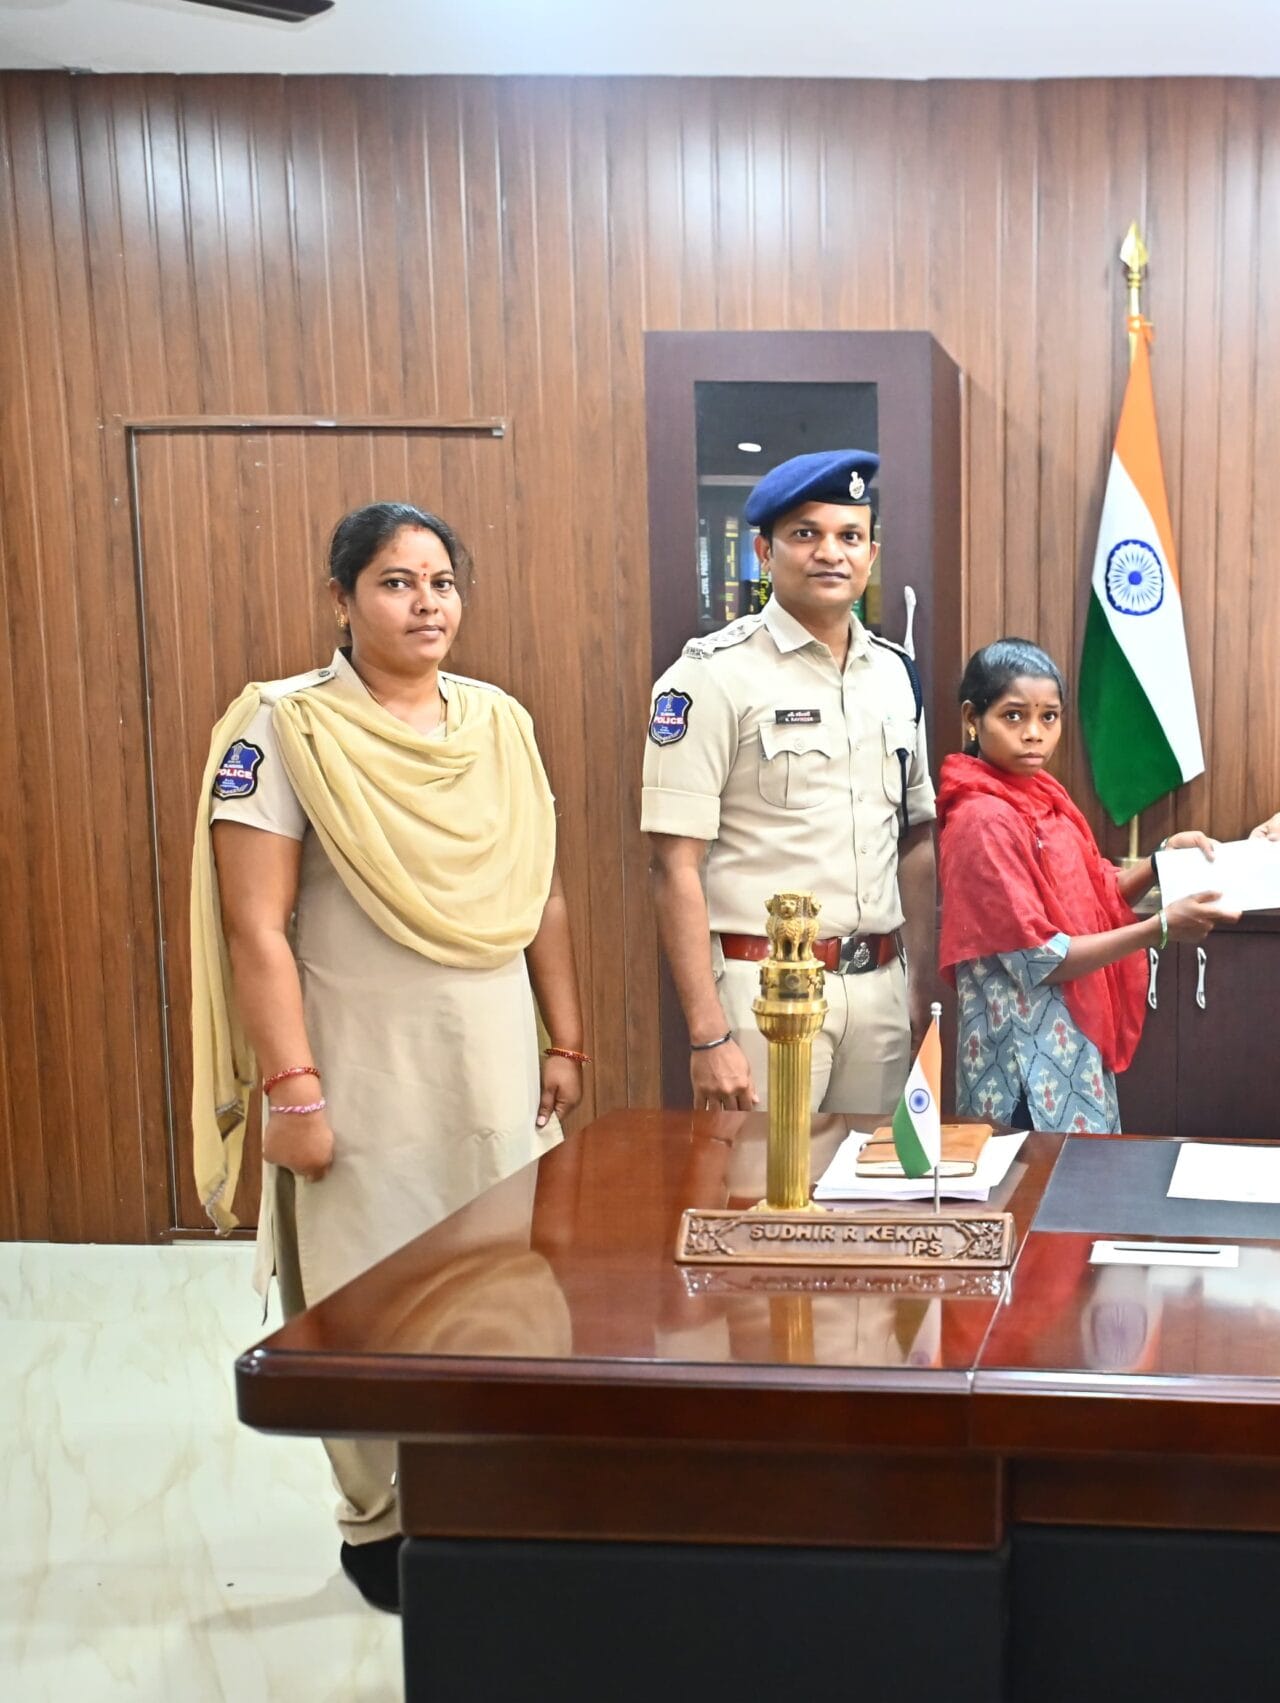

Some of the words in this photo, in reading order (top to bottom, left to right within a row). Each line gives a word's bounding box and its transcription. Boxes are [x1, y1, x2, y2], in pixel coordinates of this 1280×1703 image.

[750, 1223, 835, 1241] SUDHIR
[842, 1225, 857, 1242] R
[863, 1225, 943, 1241] KEKAN
[907, 1241, 943, 1257] IPS
